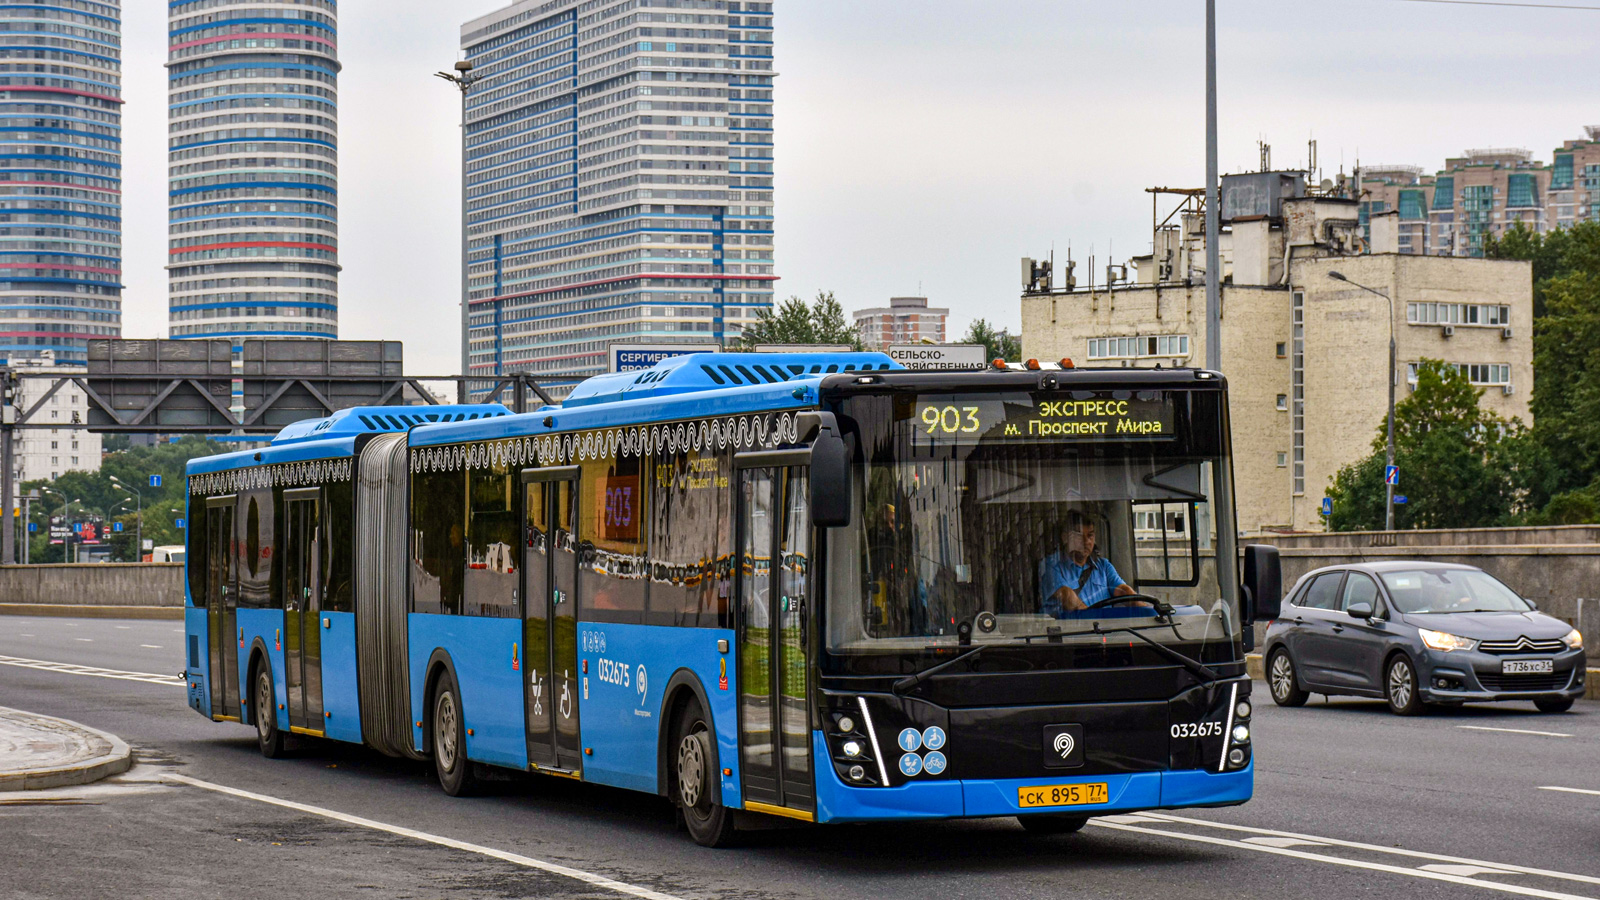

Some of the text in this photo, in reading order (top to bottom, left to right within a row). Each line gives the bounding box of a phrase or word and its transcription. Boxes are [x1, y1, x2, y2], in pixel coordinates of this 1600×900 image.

[890, 350, 945, 360] СЕЛЬСКО-
[1039, 401, 1128, 417] ЭКСПРЕСС
[922, 405, 980, 433] 903
[1004, 418, 1162, 437] м. Проспект Мира
[656, 464, 674, 488] 903
[605, 487, 632, 527] 903
[598, 658, 630, 688] 032675
[1513, 662, 1529, 671] 736
[1170, 721, 1223, 738] 032675
[1026, 784, 1102, 804] СК 895 77
